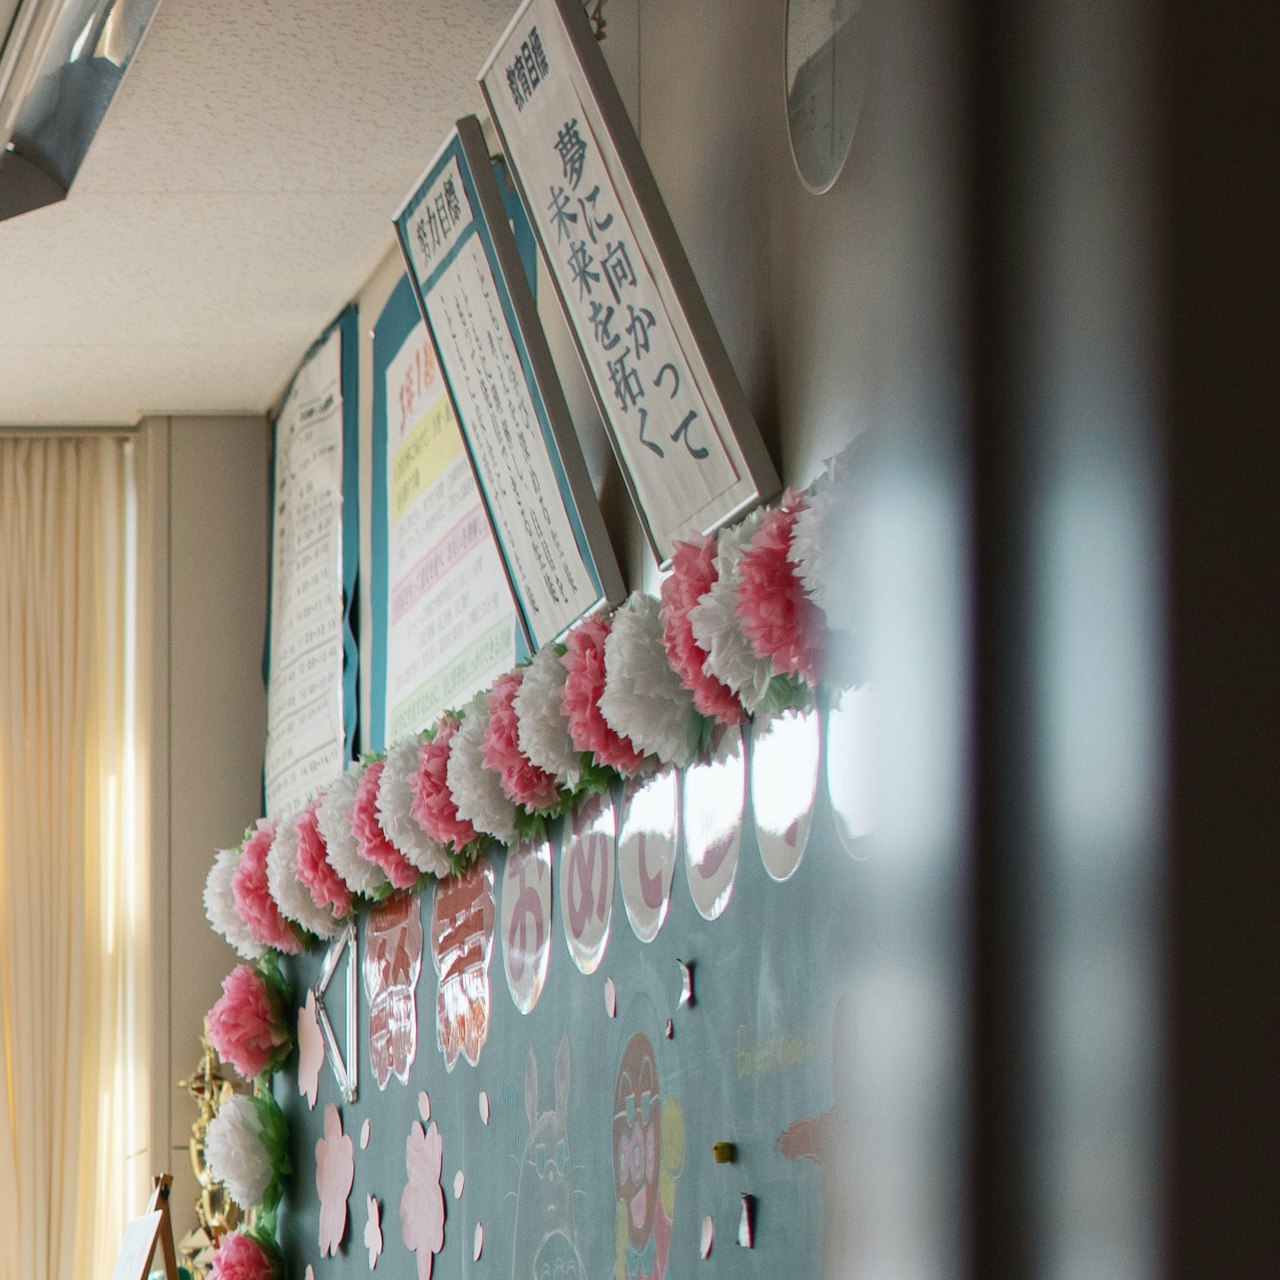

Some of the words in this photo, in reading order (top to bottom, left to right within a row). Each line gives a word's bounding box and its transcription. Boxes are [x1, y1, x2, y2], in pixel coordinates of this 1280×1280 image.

[505, 25, 549, 112] 教育目標
[415, 173, 461, 267] 努力目標
[553, 117, 710, 461] 夢に向かって
[546, 185, 665, 459] 未来を拓く
